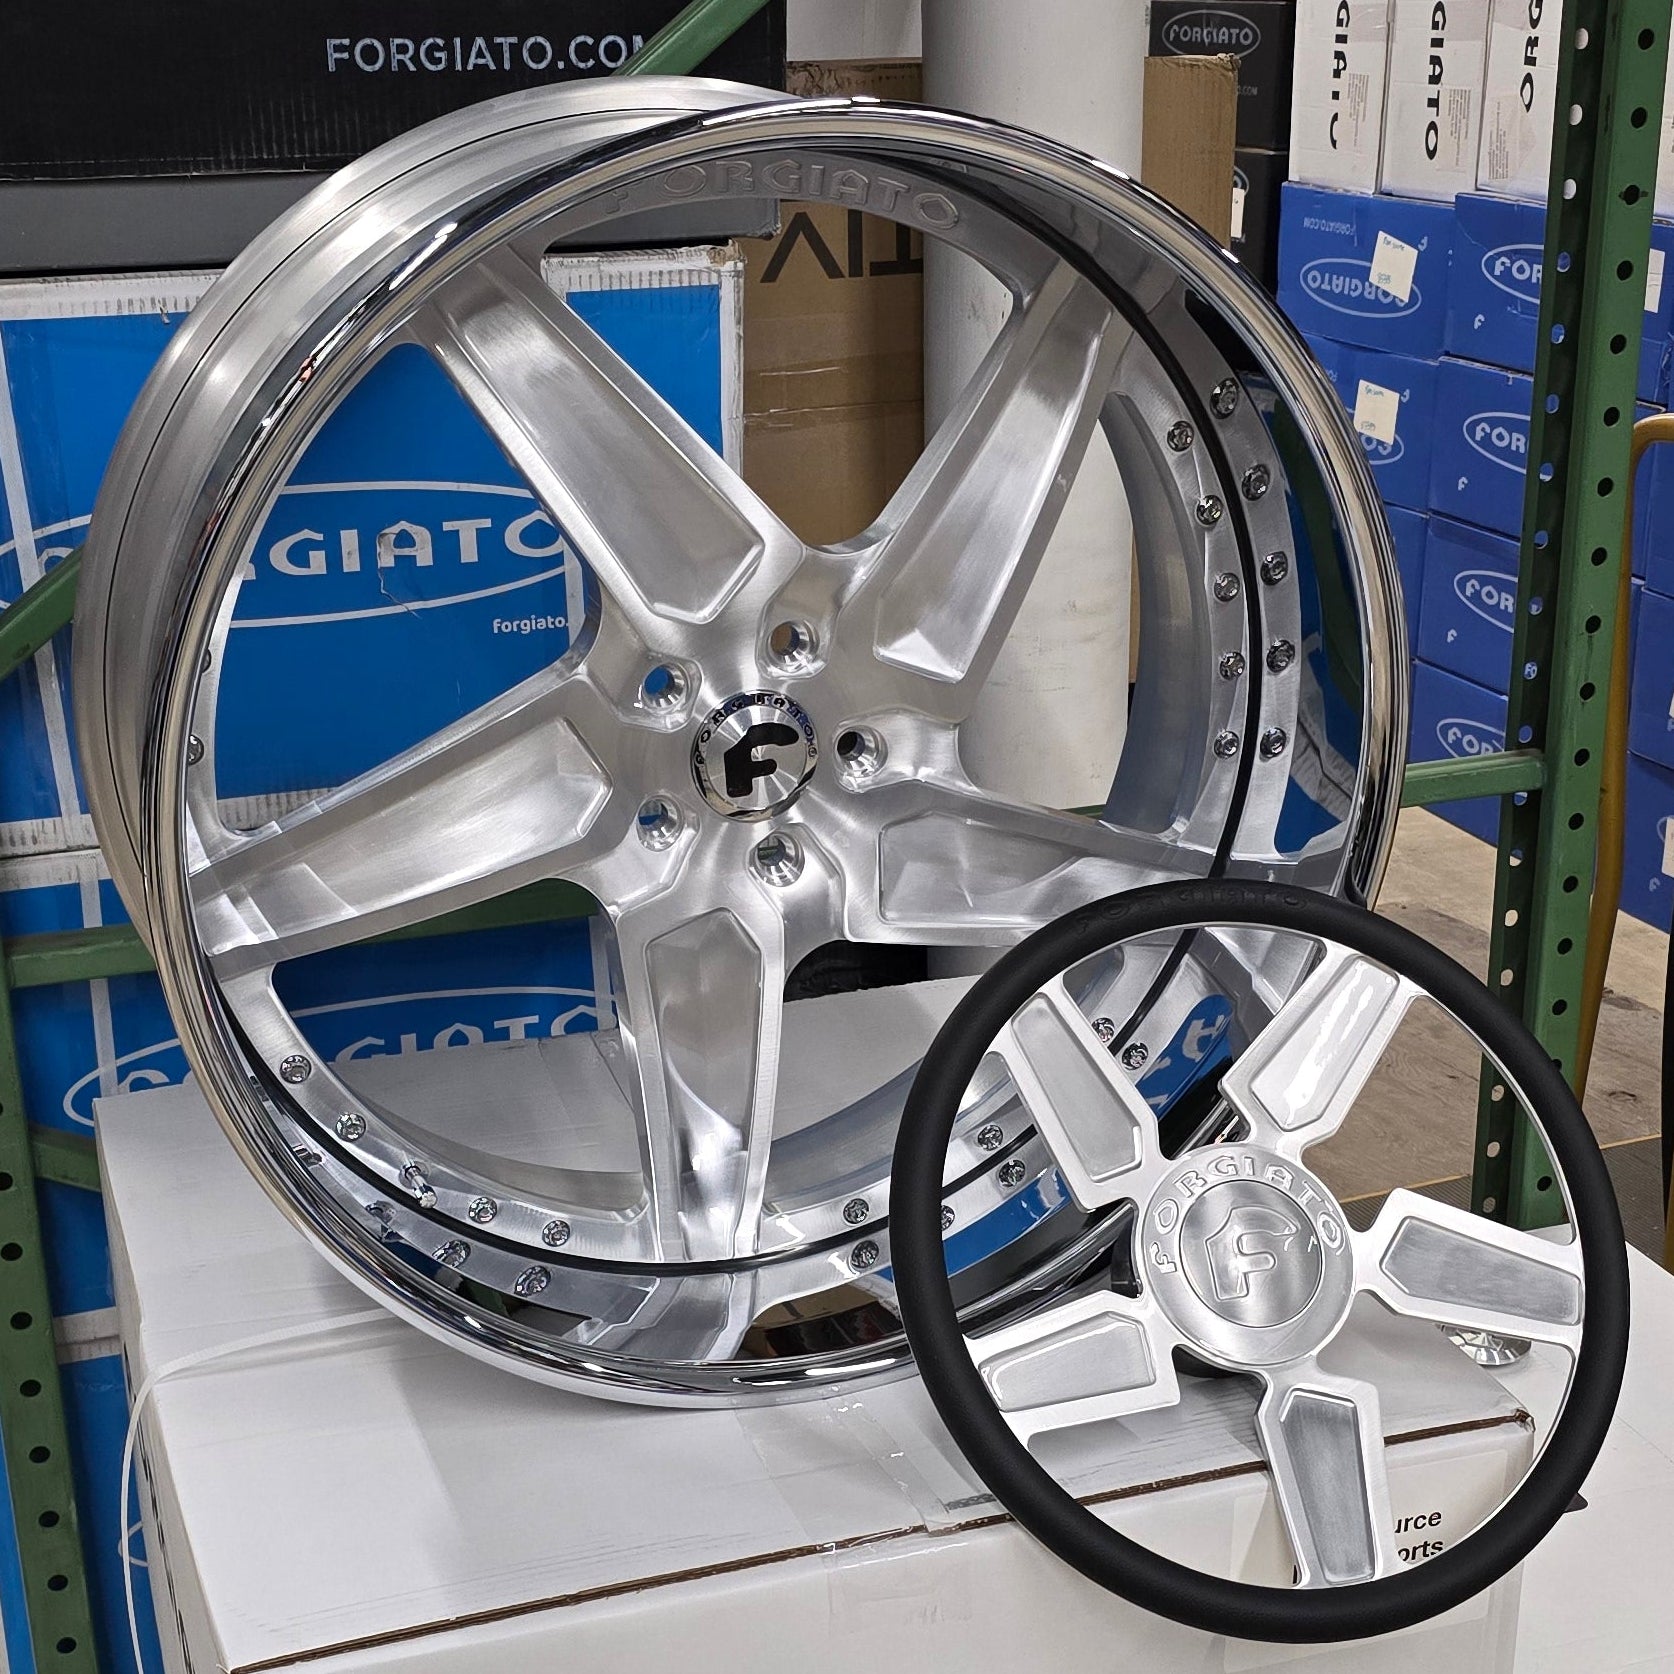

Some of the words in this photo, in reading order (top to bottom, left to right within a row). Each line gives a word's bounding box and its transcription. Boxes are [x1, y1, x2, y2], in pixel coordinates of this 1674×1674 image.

[1169, 24, 1253, 46] FORGIATO
[604, 158, 961, 231] FORGIATO
[1475, 422, 1527, 454] FOR
[1465, 578, 1515, 614] FOR
[723, 722, 799, 798] F
[1151, 1155, 1346, 1274] FORGIATO
